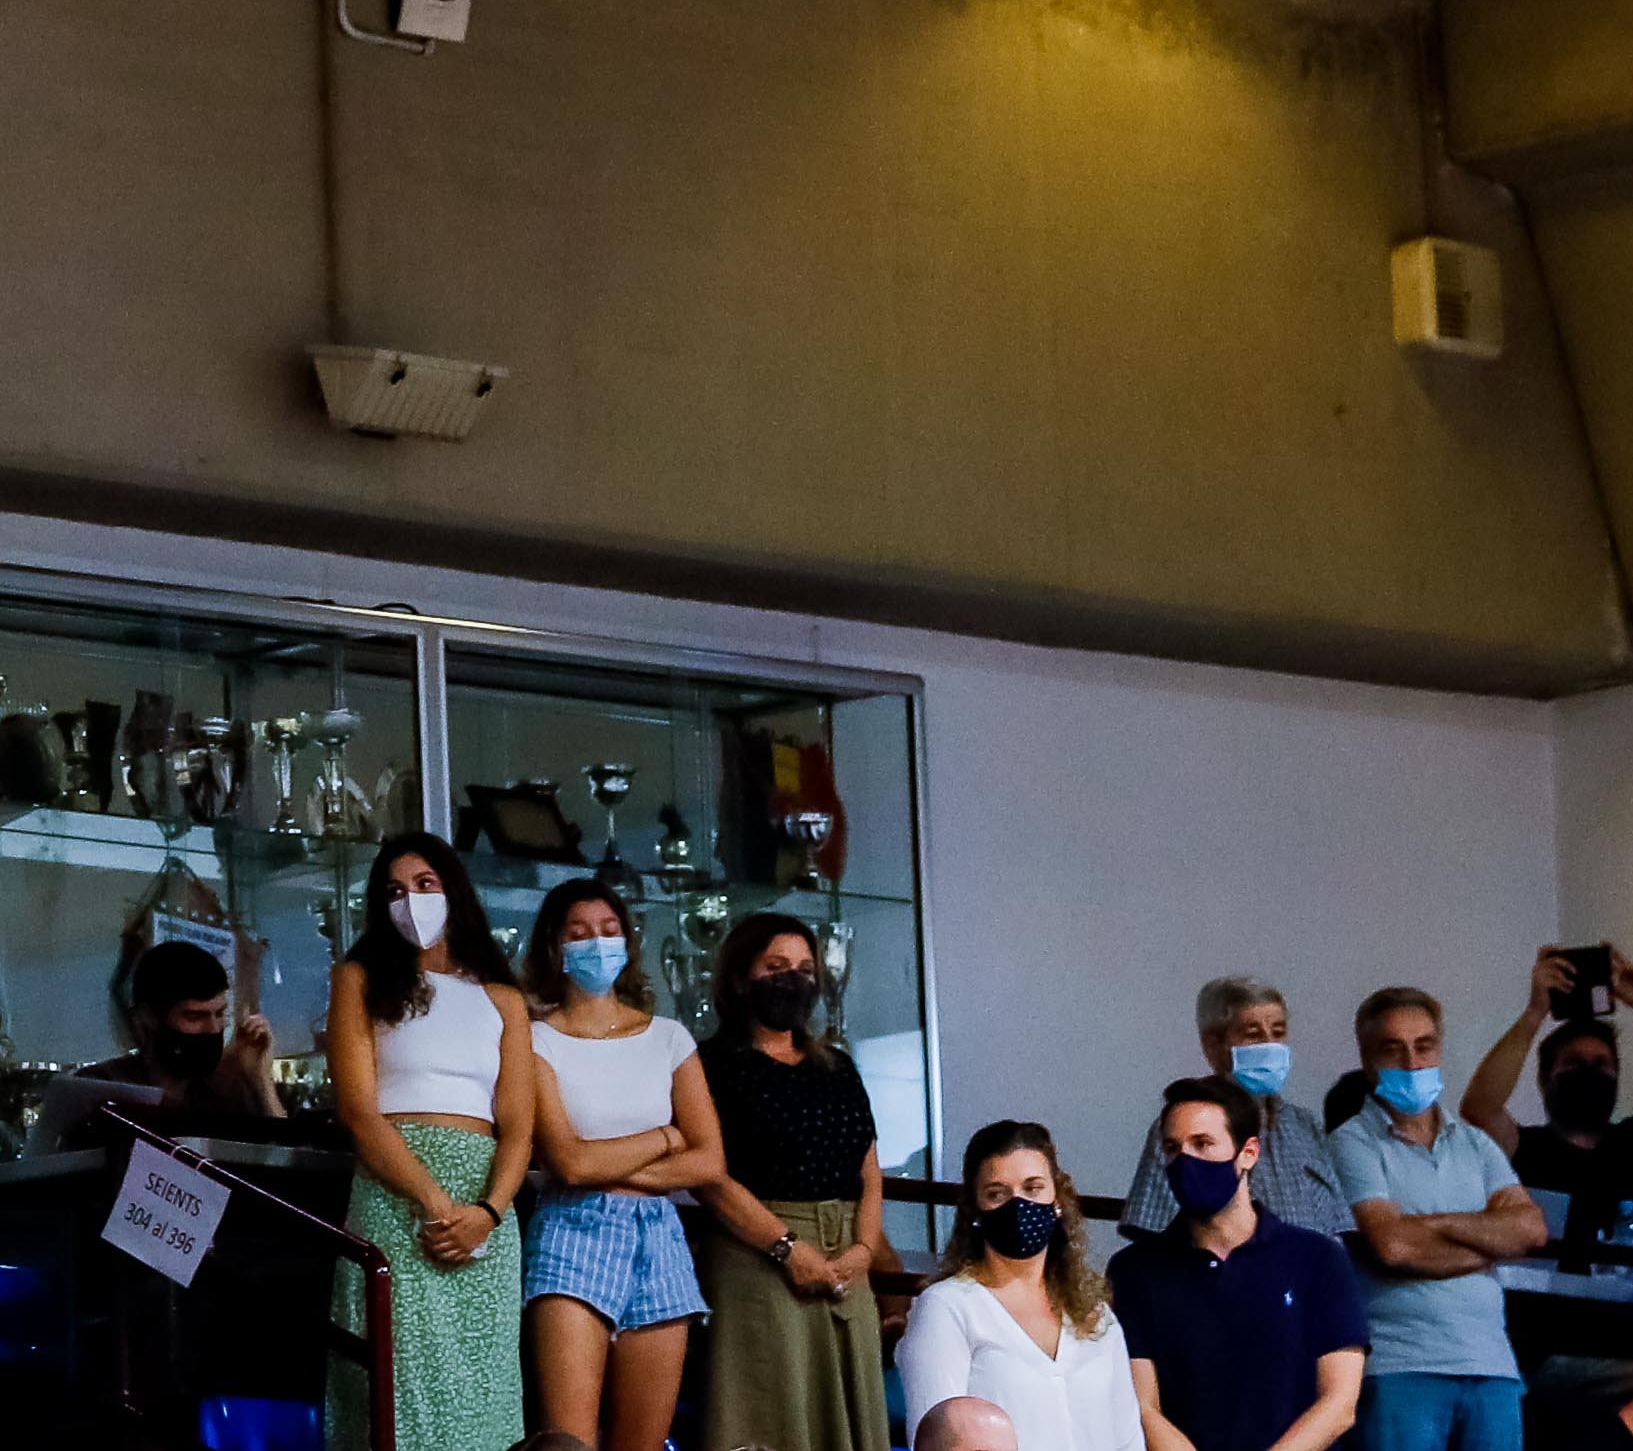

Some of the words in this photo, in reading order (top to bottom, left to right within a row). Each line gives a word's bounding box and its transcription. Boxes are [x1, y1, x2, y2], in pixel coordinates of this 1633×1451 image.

[144, 1171, 203, 1217] SEIENTS
[123, 1202, 153, 1230] 304
[151, 1221, 169, 1239] al
[166, 1226, 197, 1254] 396
